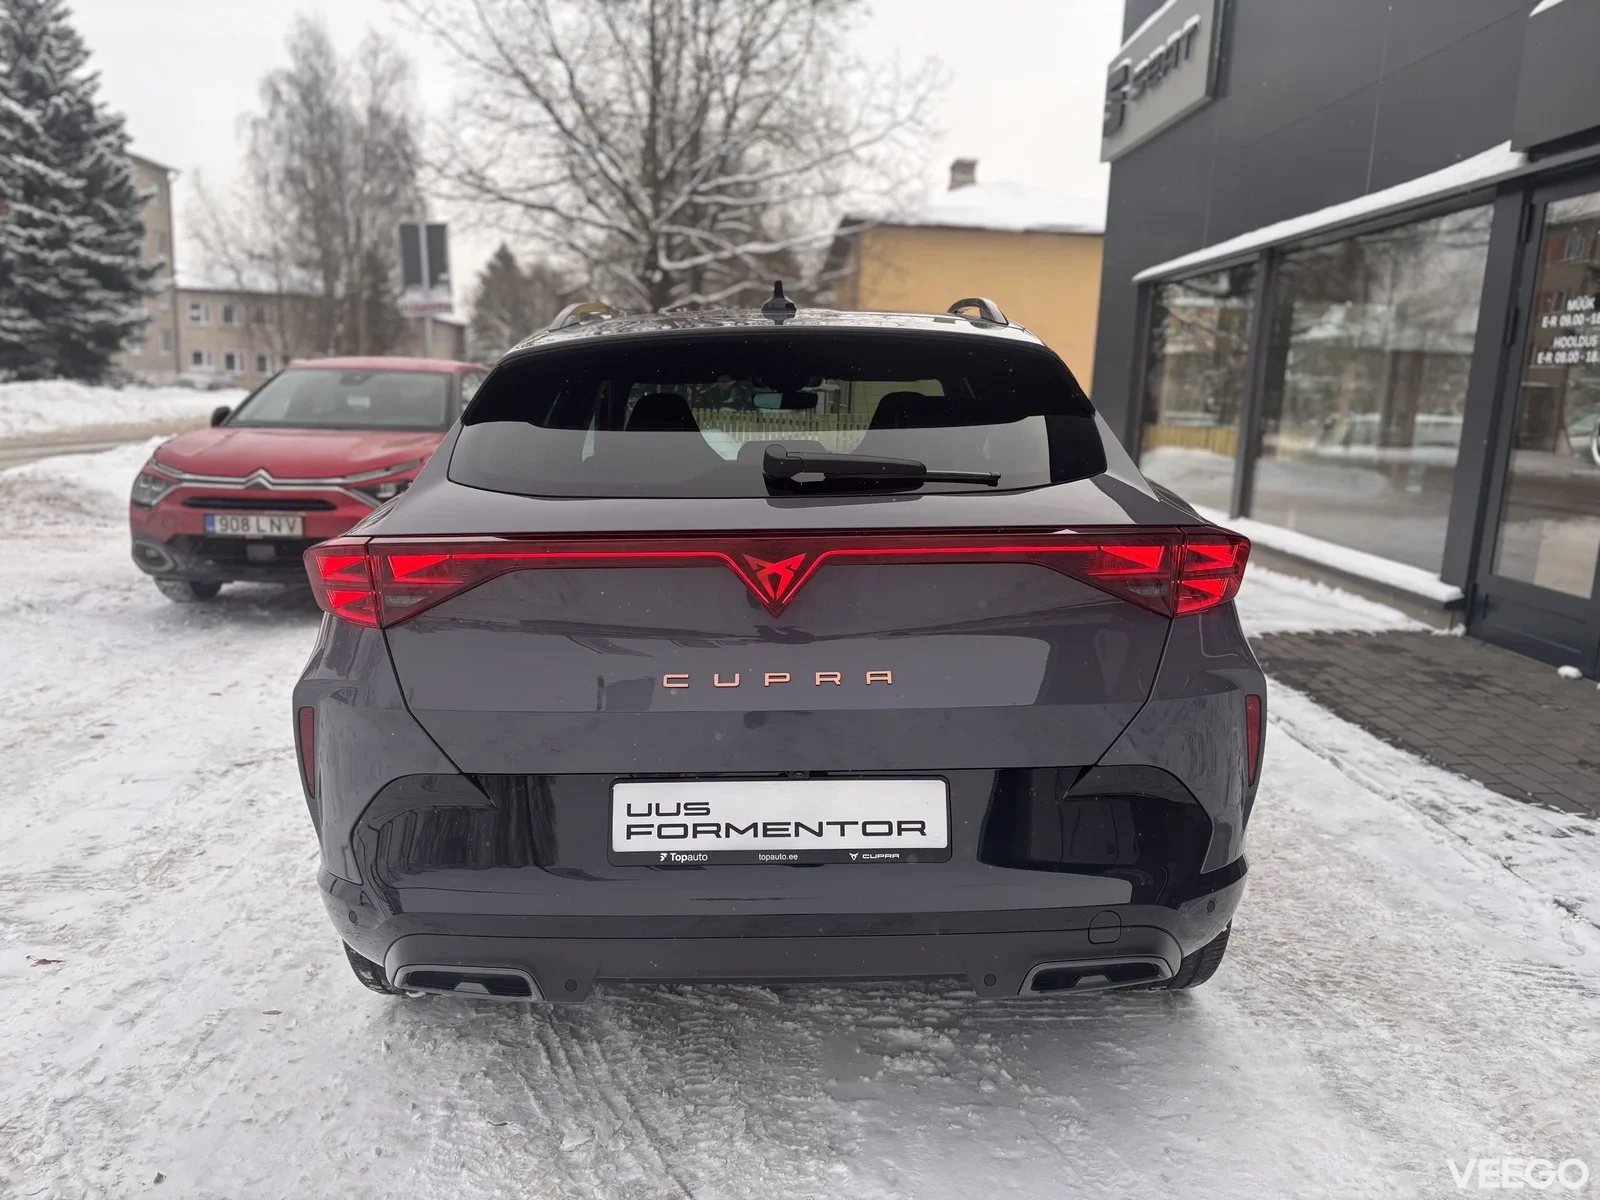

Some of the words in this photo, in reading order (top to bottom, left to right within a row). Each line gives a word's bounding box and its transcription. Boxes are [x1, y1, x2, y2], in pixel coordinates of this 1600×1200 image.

[1553, 334, 1598, 349] HOOLDUS
[219, 516, 250, 532] 908
[256, 516, 298, 533] LNV
[662, 670, 893, 688] CUPRA
[626, 802, 711, 817] UUS
[626, 820, 927, 840] FORMENTOR
[670, 852, 708, 863] Topauto
[758, 853, 798, 862] topauto.ee
